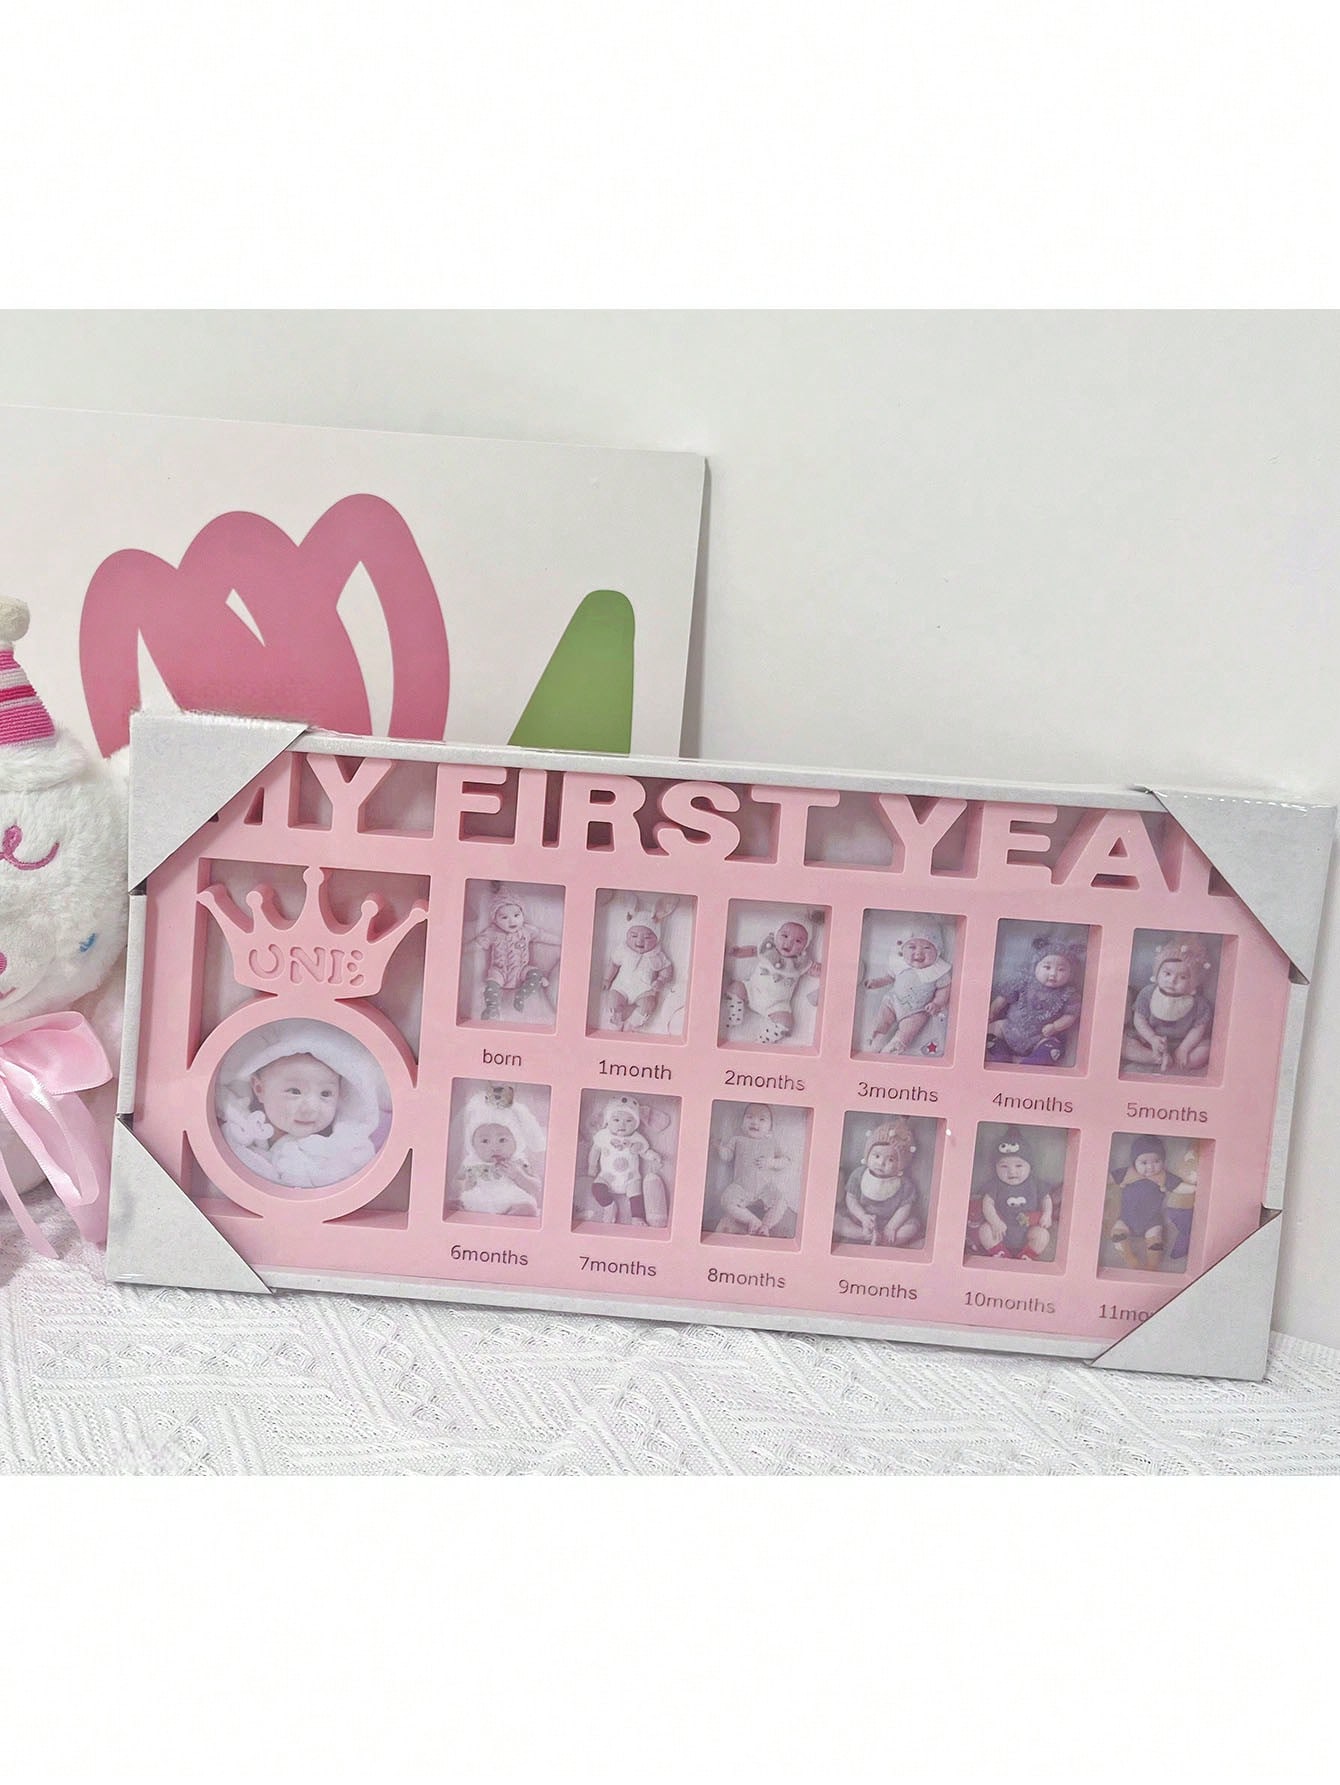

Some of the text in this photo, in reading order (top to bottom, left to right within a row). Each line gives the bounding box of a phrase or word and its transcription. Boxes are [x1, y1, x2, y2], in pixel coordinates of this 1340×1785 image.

[434, 763, 840, 866] FIRST
[249, 943, 365, 986] ONE
[482, 1048, 523, 1067] born
[598, 1060, 673, 1080] 1month
[724, 1070, 806, 1092] 2months
[857, 1081, 939, 1103] 3months
[992, 1092, 1074, 1113] 4months
[1126, 1102, 1209, 1123] 5months
[450, 1245, 529, 1266] 6months
[578, 1256, 657, 1277] 7months
[707, 1267, 787, 1289] 8months
[838, 1279, 918, 1301] 9months
[964, 1291, 1056, 1314] 10months
[1098, 1303, 1154, 1322] 11mo
